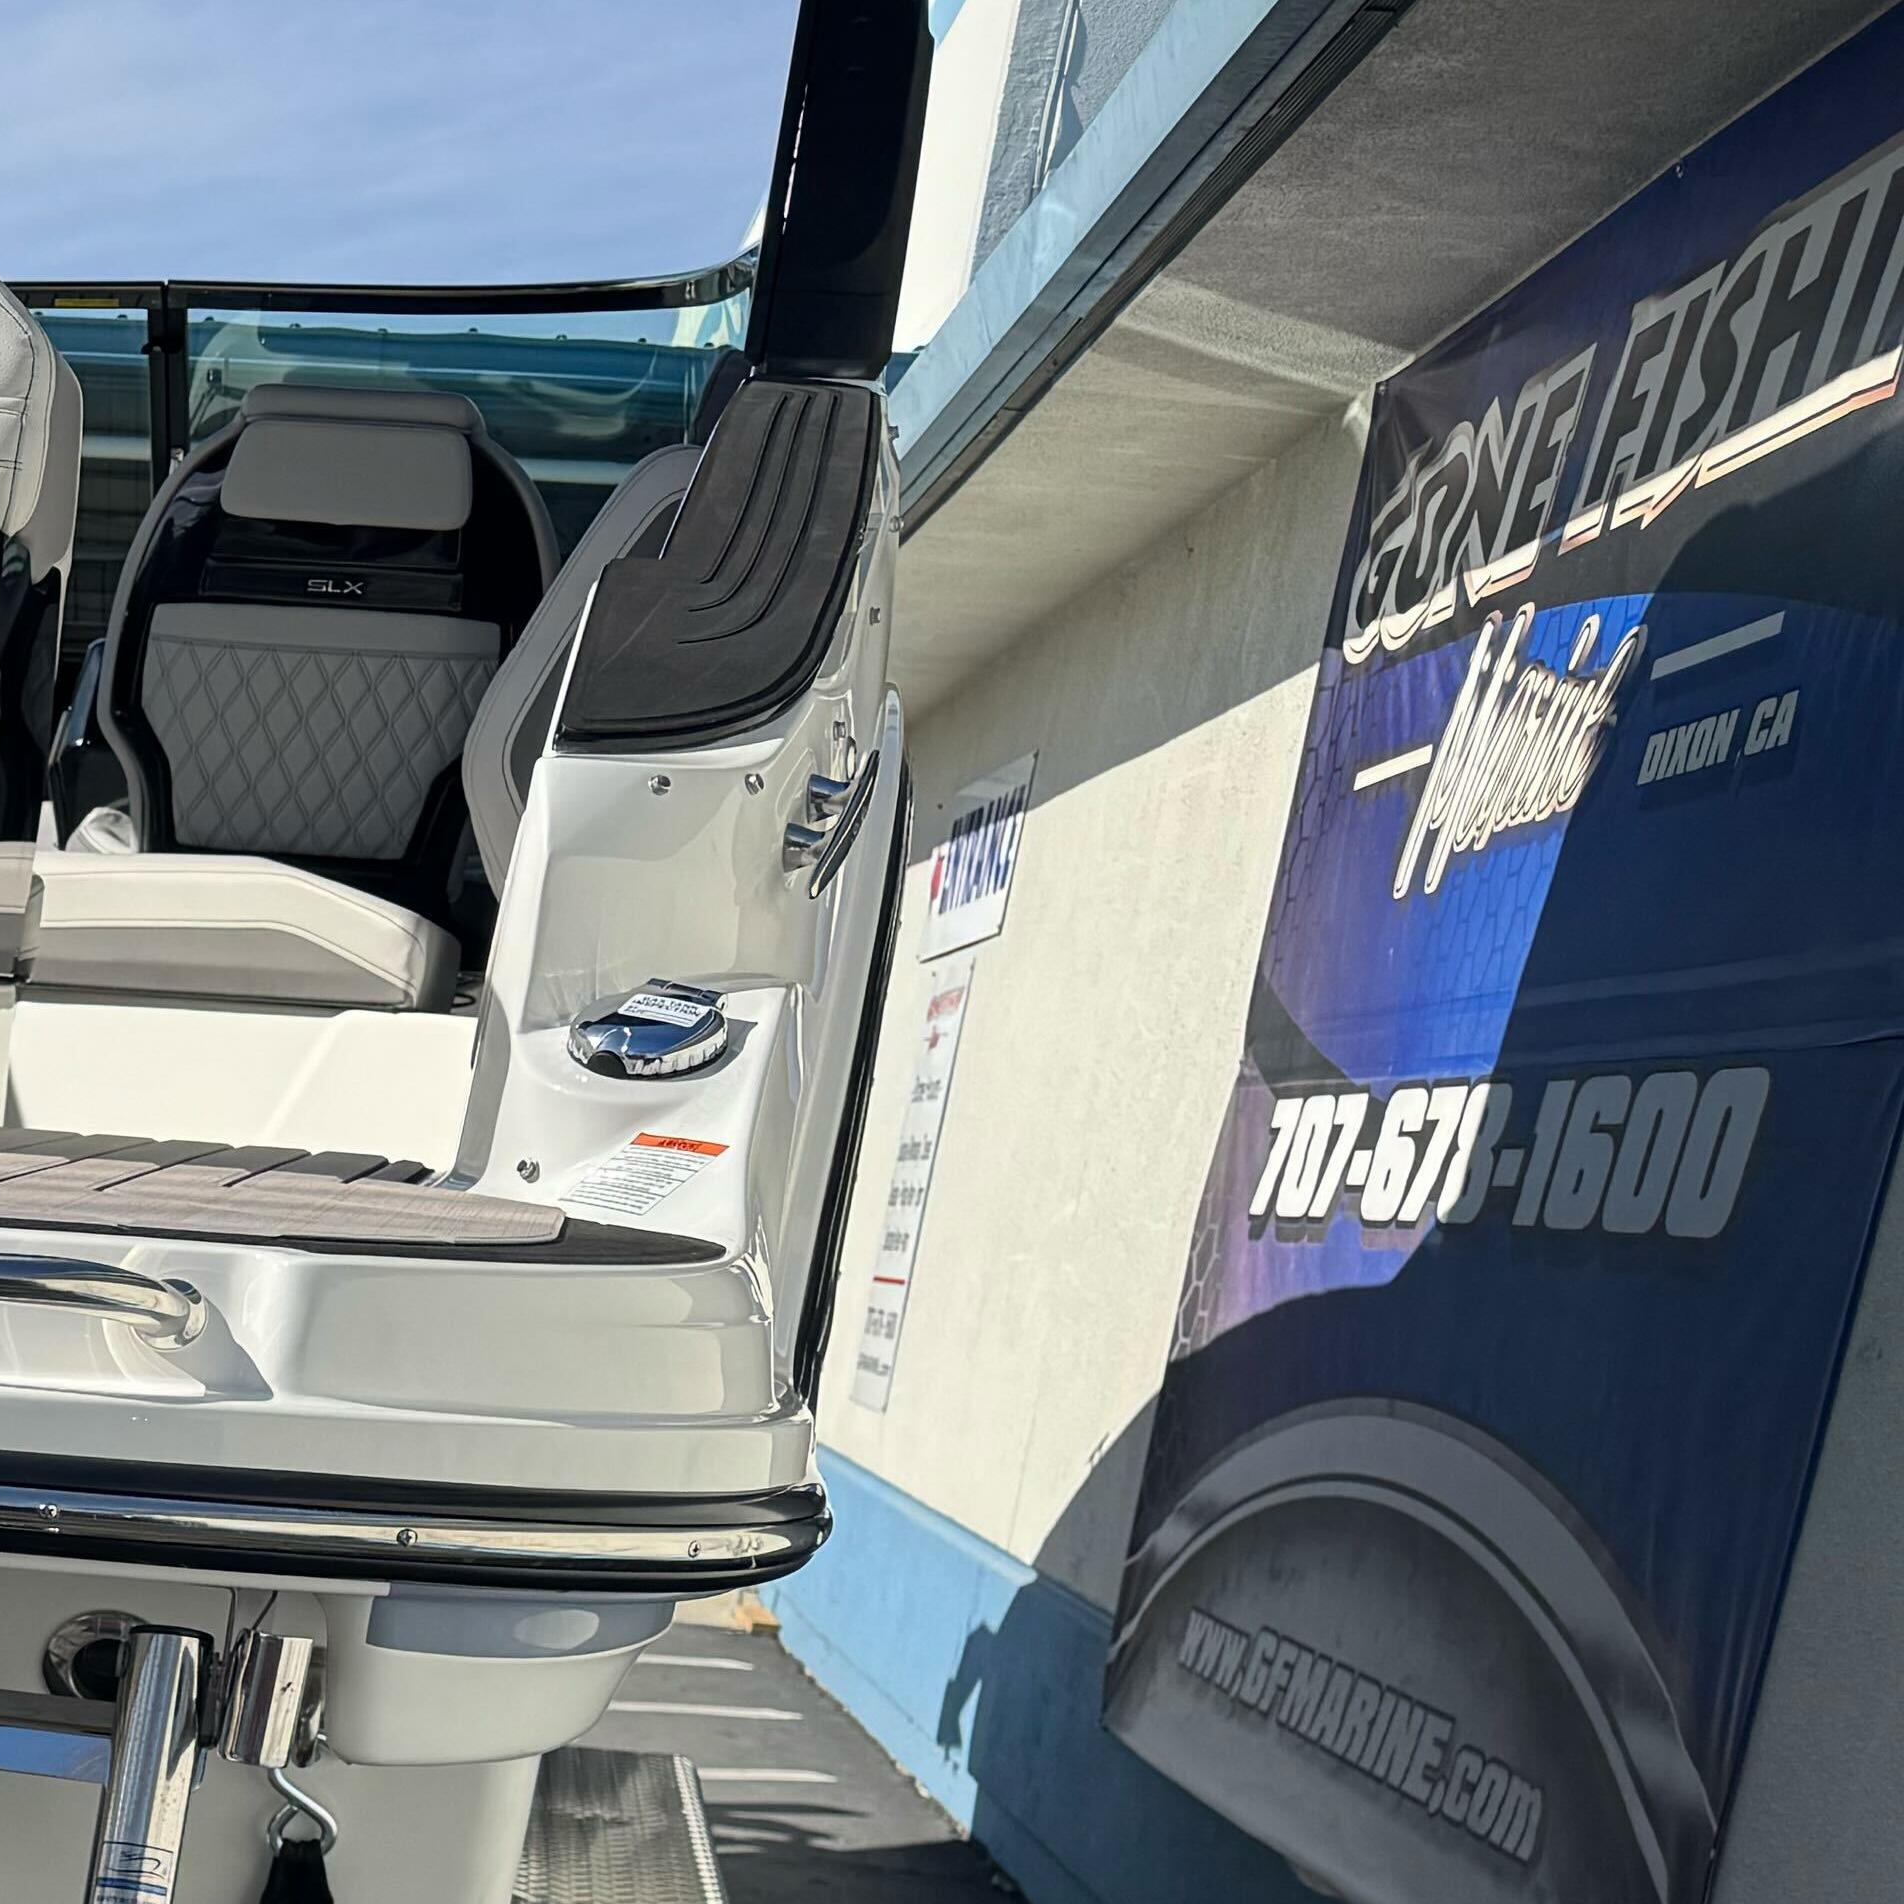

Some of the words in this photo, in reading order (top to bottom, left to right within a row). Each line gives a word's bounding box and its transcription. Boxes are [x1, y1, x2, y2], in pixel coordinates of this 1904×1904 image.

[1343, 343, 1597, 664] GONE
[1558, 135, 1904, 557] FISHI
[307, 579, 364, 595] SLX
[1744, 690, 1799, 756] CA
[1248, 1067, 1770, 1239] 707-678-1600
